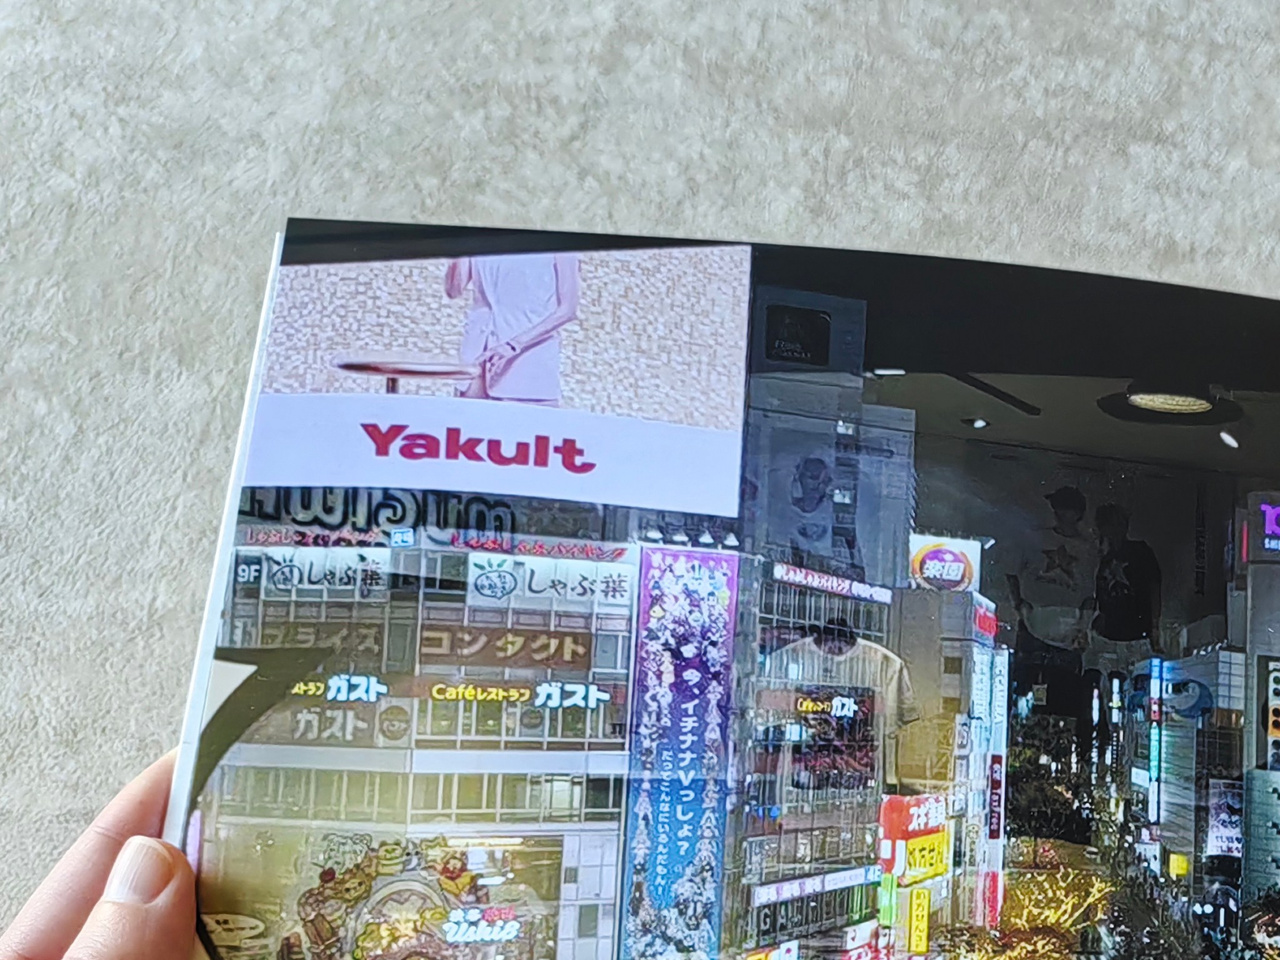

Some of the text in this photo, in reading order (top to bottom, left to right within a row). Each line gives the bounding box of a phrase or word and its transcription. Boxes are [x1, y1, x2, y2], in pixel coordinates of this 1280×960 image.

[361, 423, 597, 475] Yakult
[237, 564, 261, 583] 9F
[526, 567, 629, 601] しゃぶ葉
[421, 629, 587, 661] コンタクト
[326, 674, 389, 703] ガスト
[535, 681, 612, 710] ガスト
[293, 707, 369, 741] ガスト
